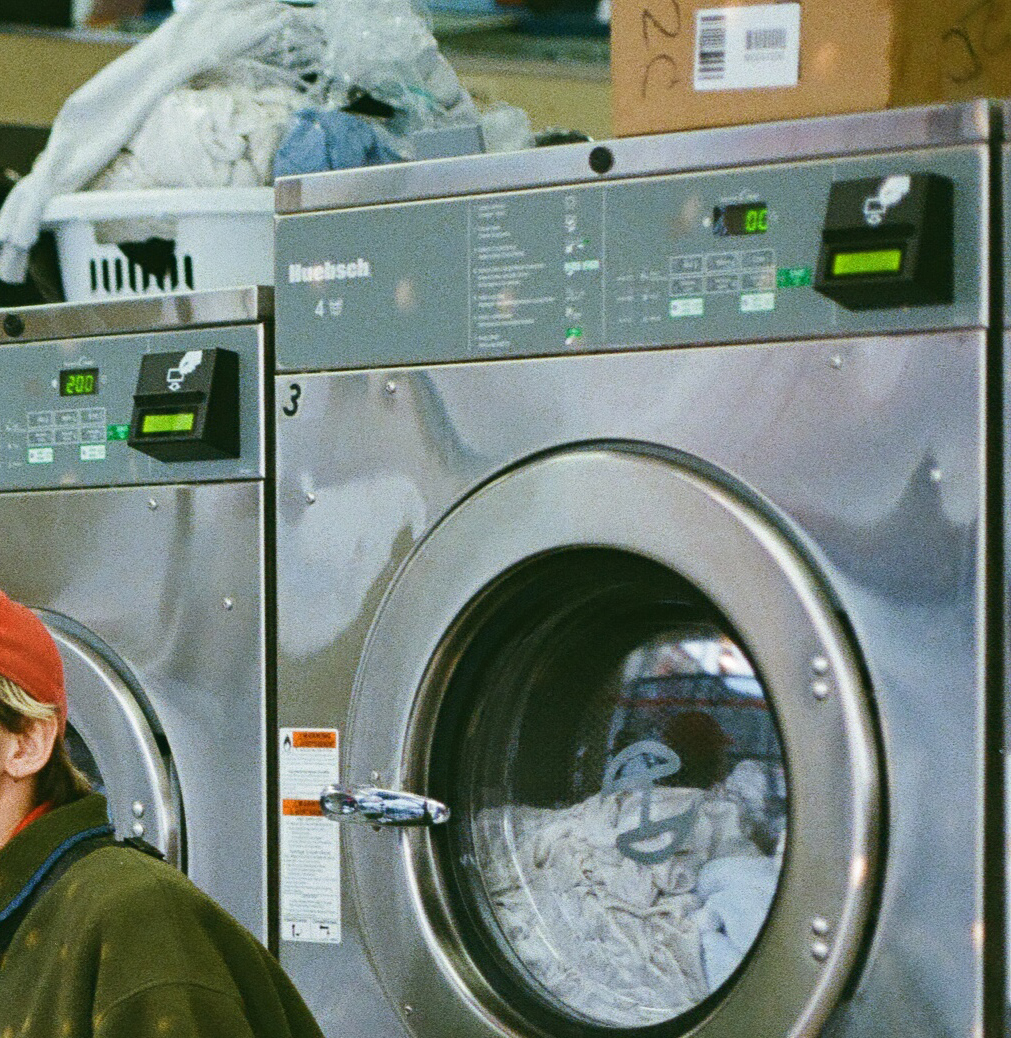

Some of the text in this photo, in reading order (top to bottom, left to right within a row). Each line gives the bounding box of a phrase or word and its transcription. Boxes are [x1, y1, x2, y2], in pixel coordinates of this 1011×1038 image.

[289, 258, 370, 283] Huebsch
[66, 374, 94, 394] 200
[283, 383, 302, 417] 3
